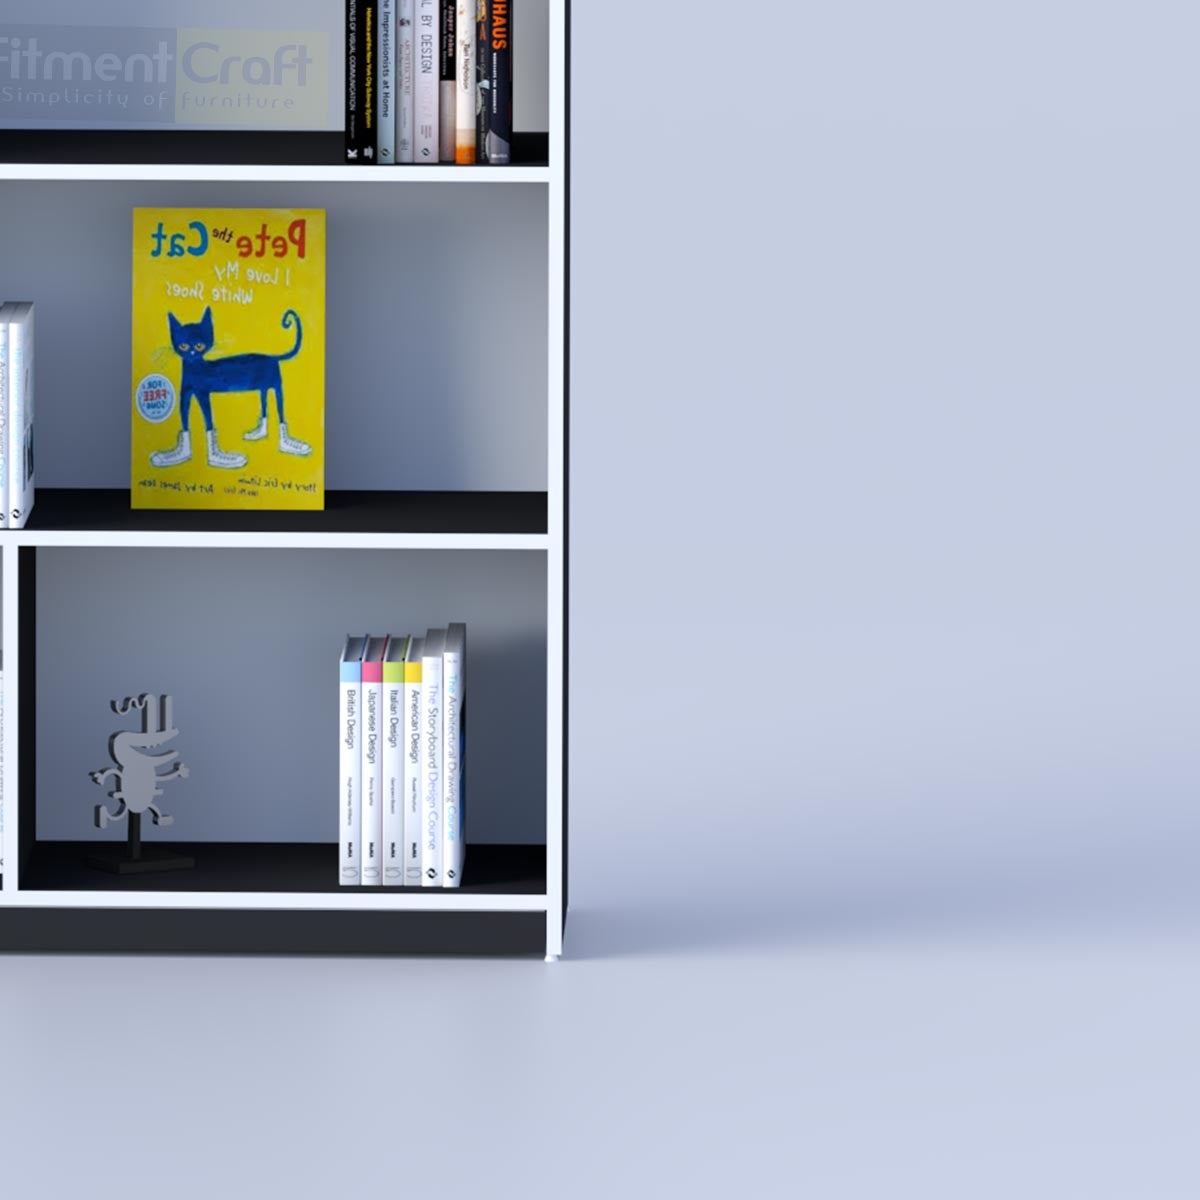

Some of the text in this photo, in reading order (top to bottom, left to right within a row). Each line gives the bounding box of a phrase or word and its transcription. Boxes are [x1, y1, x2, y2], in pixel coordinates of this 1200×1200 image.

[380, 12, 391, 77] Impressionists
[421, 15, 432, 27] BY
[383, 80, 390, 89] at
[421, 34, 432, 74] DESIGN
[383, 92, 391, 118] Home
[345, 689, 355, 750] British Design
[367, 689, 376, 764] Japanese Design
[388, 689, 398, 748] Italian Design
[409, 689, 420, 764] American Design
[426, 684, 438, 850] The Storyboard Design Course
[446, 696, 457, 841] Architectural Drawing Course
